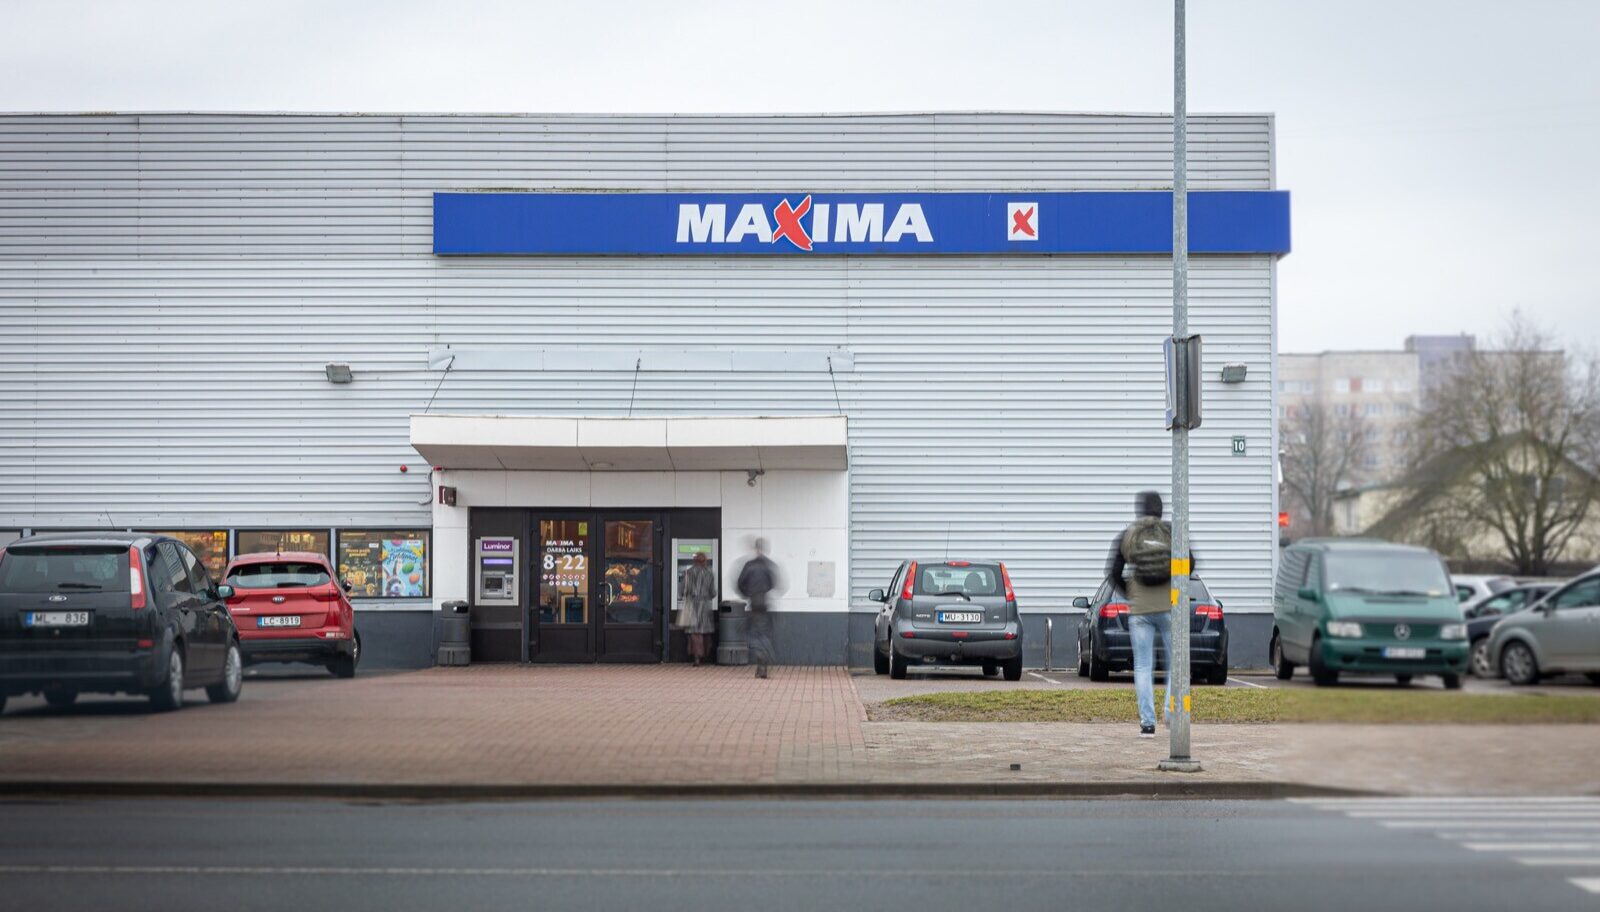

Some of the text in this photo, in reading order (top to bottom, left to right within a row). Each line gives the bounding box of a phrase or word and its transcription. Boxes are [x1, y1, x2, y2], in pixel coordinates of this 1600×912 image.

[676, 194, 934, 251] MAXIMA
[1234, 440, 1245, 452] 10
[483, 542, 511, 550] Luminor
